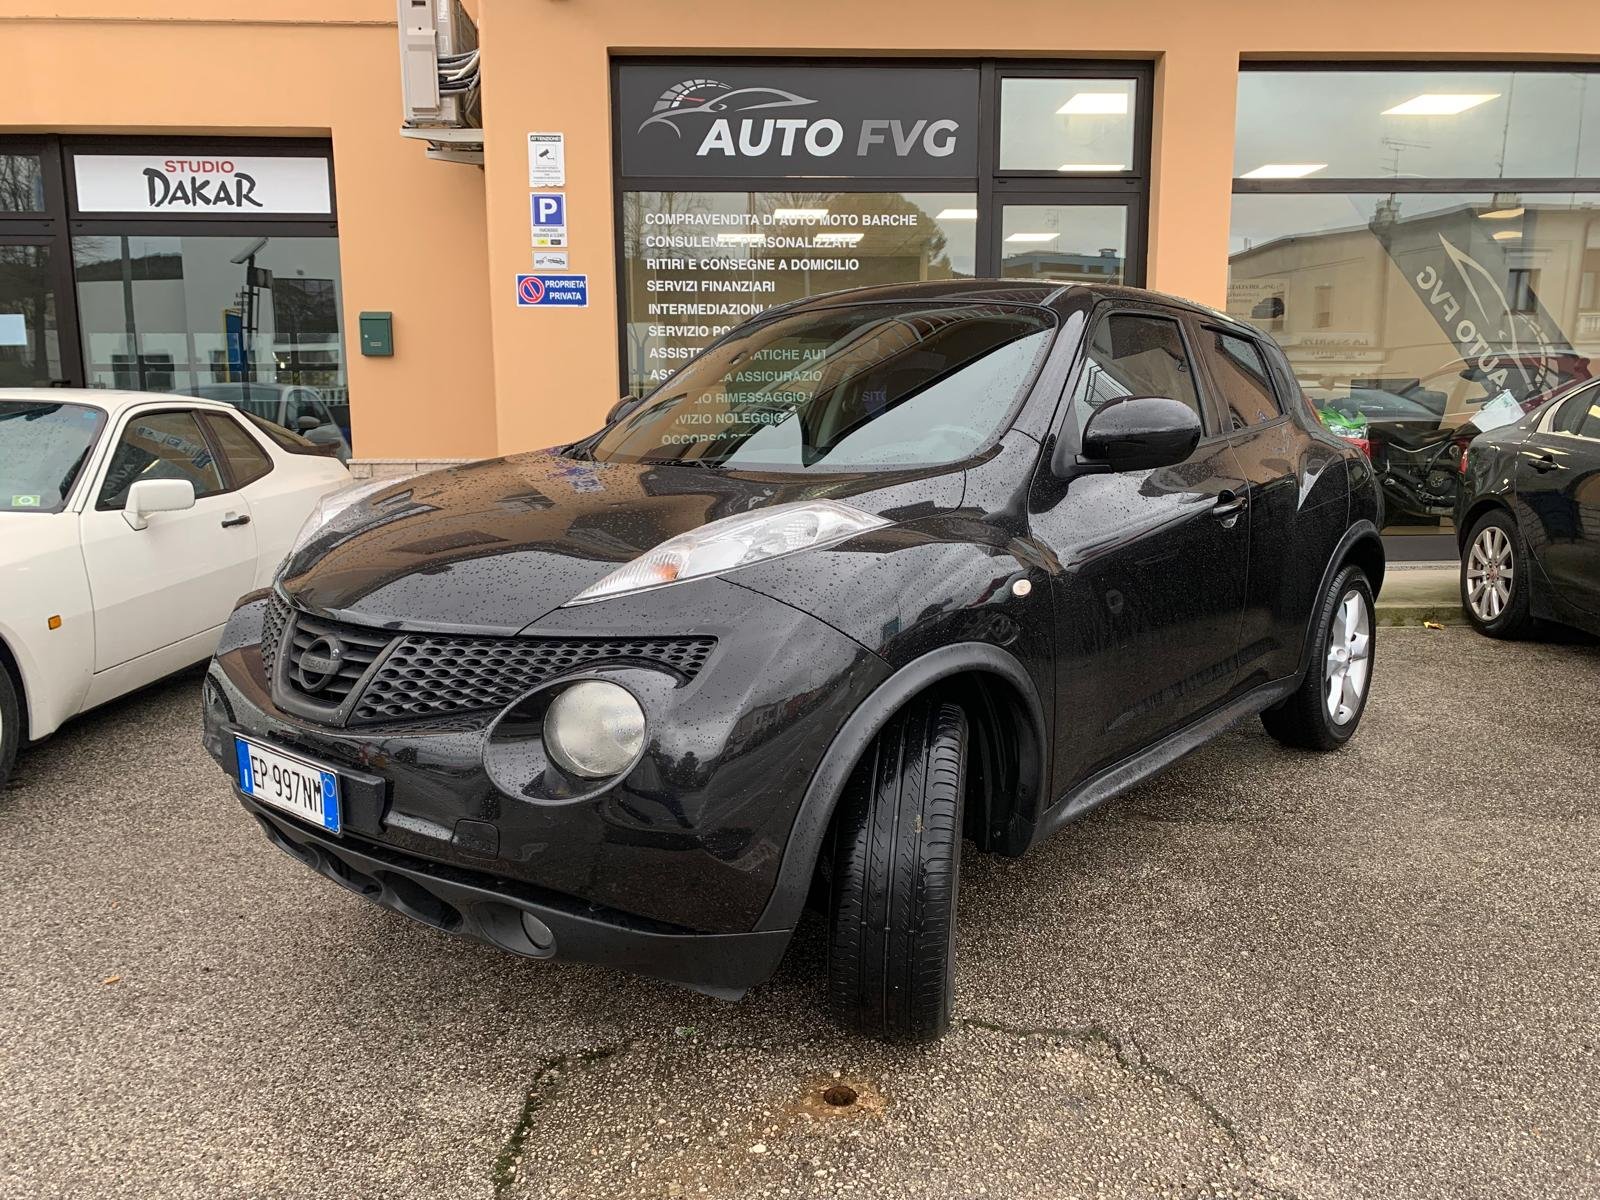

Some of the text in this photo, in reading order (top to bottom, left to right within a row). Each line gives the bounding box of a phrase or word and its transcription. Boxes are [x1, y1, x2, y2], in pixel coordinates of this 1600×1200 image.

[696, 118, 960, 157] AUTO FVG
[164, 160, 234, 174] STUDIO
[143, 167, 263, 207] DAKAR
[539, 198, 558, 223] P
[645, 213, 918, 226] COMPRAVENDITA DI AUTO MOTO BARCHE
[646, 236, 858, 248] CONSULENZE PERSONALIZZATE
[646, 258, 859, 271] RITIRI E CONSEGNE A DOMICILIO
[545, 280, 586, 289] PROPRIETA'
[647, 280, 775, 292] SERVIZI FINANZIARI
[549, 291, 582, 300] PRIVATA
[648, 303, 764, 315] INTERMEDIAZIONI
[648, 325, 736, 337] SERVIZIO PO
[750, 349, 800, 360] ATICHE
[736, 371, 823, 382] ASSICURAZIO
[715, 391, 806, 404] RIMESSAGGIO
[675, 413, 783, 425] VIZIO NOLEGGIO
[250, 755, 324, 815] EP 997NM
